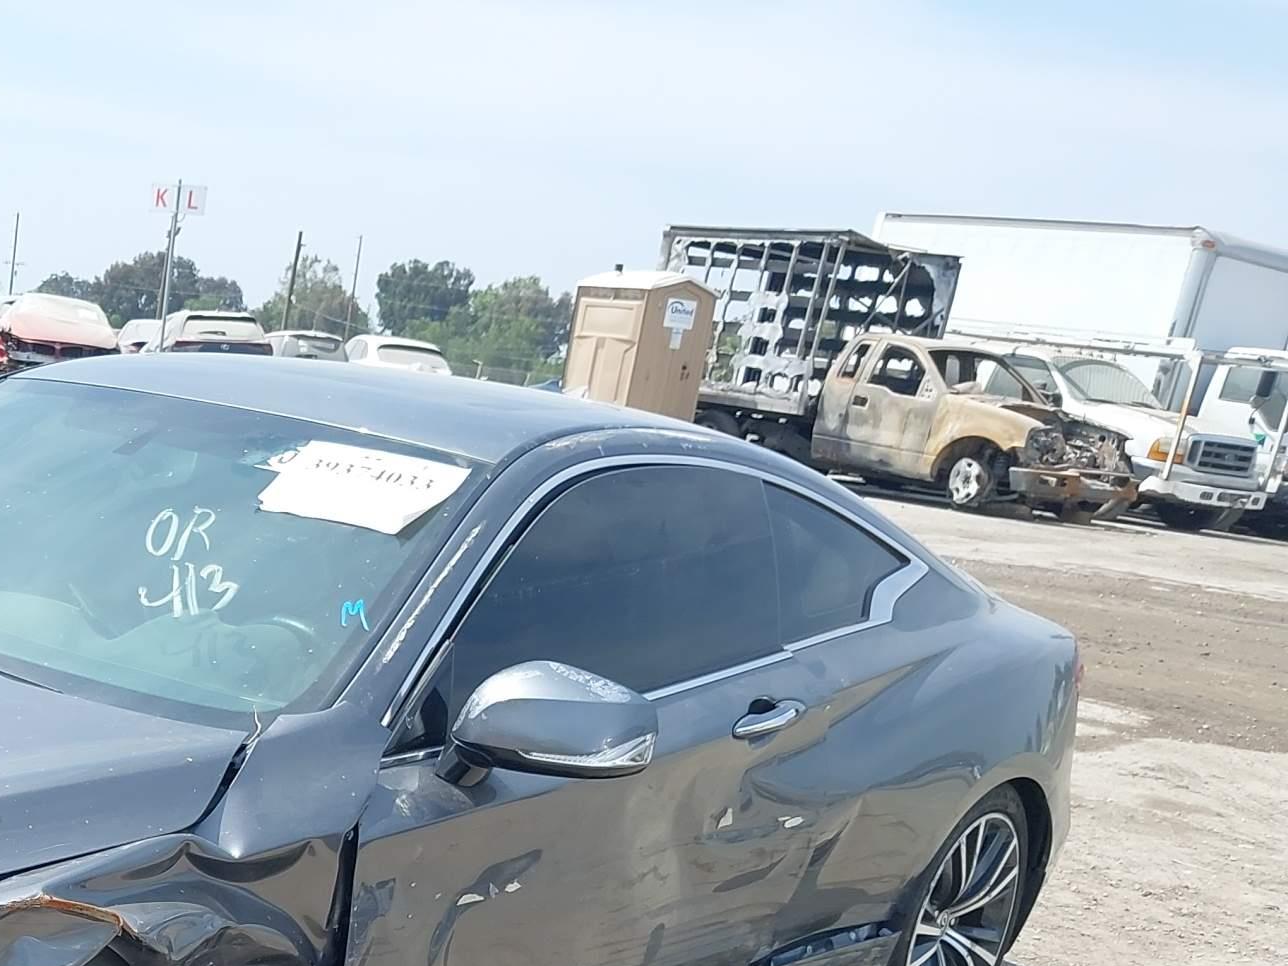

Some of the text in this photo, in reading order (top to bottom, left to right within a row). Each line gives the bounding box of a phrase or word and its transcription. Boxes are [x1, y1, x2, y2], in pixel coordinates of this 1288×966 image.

[155, 188, 199, 210] K L
[341, 599, 370, 632] M
